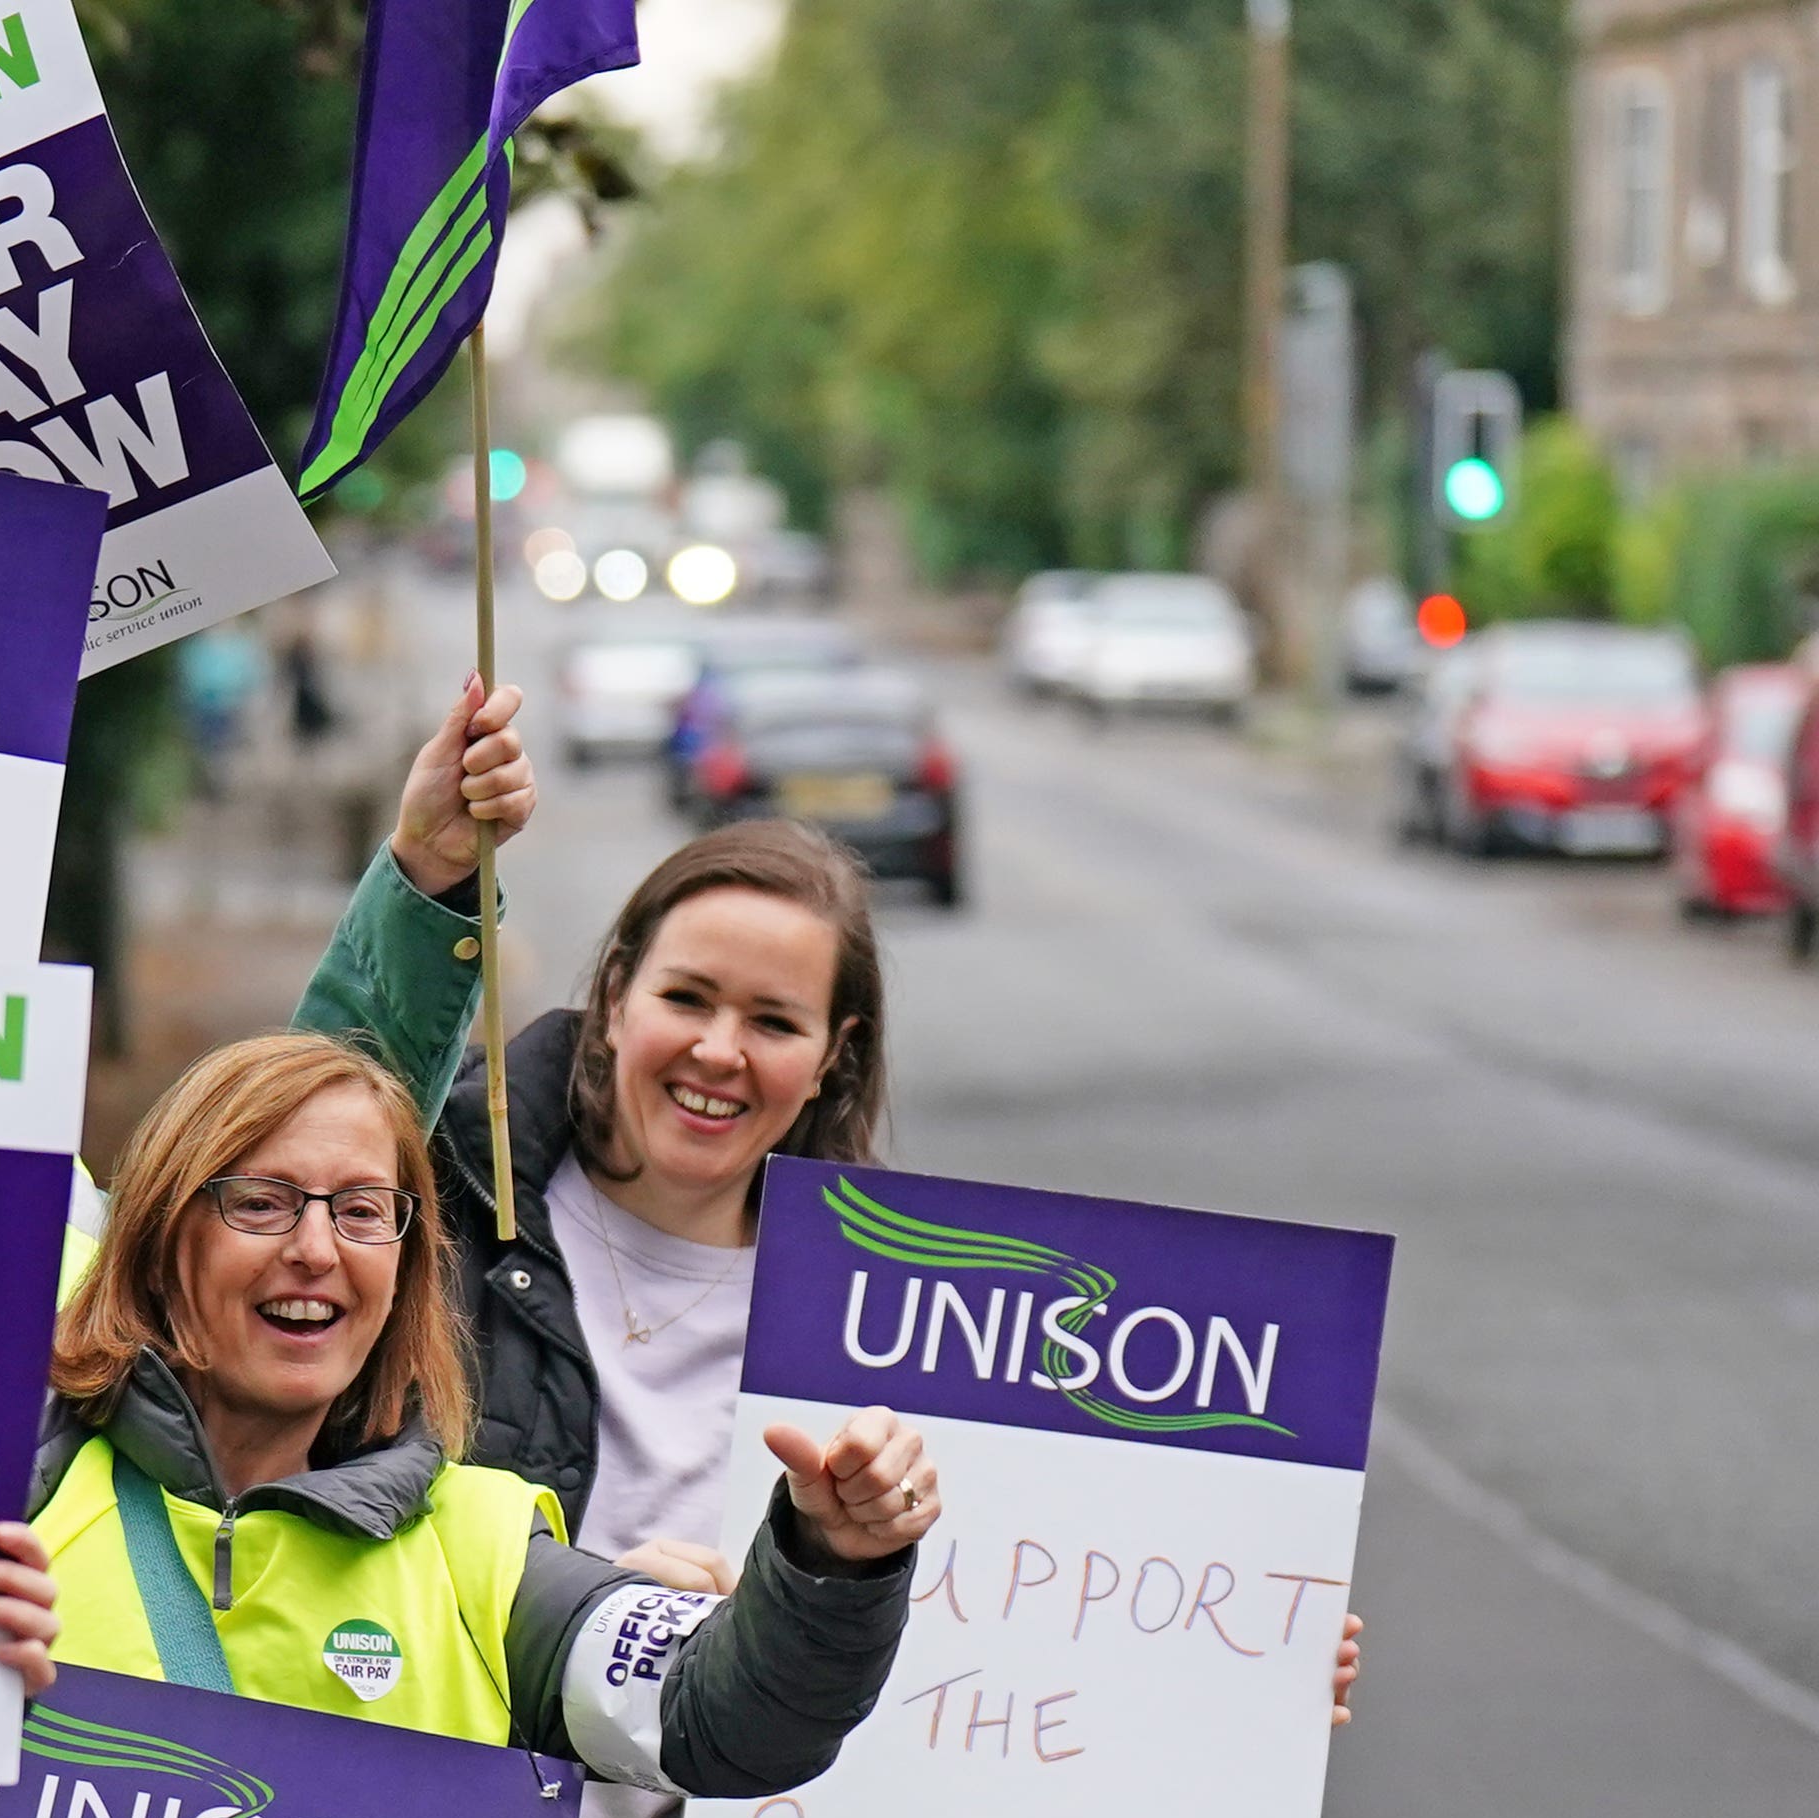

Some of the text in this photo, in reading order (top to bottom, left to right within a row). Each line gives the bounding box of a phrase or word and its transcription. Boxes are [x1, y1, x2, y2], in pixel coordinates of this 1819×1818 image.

[88, 558, 176, 622] SON
[106, 614, 156, 643] service
[159, 596, 203, 622] union
[843, 1269, 1283, 1416] UNISON
[908, 1537, 1349, 1659] UPPORT
[333, 1632, 393, 1652] UNISON
[333, 1655, 392, 1666] ON STRIKE FOR
[335, 1664, 392, 1680] FAIR PAY
[902, 1669, 1087, 1764] THE
